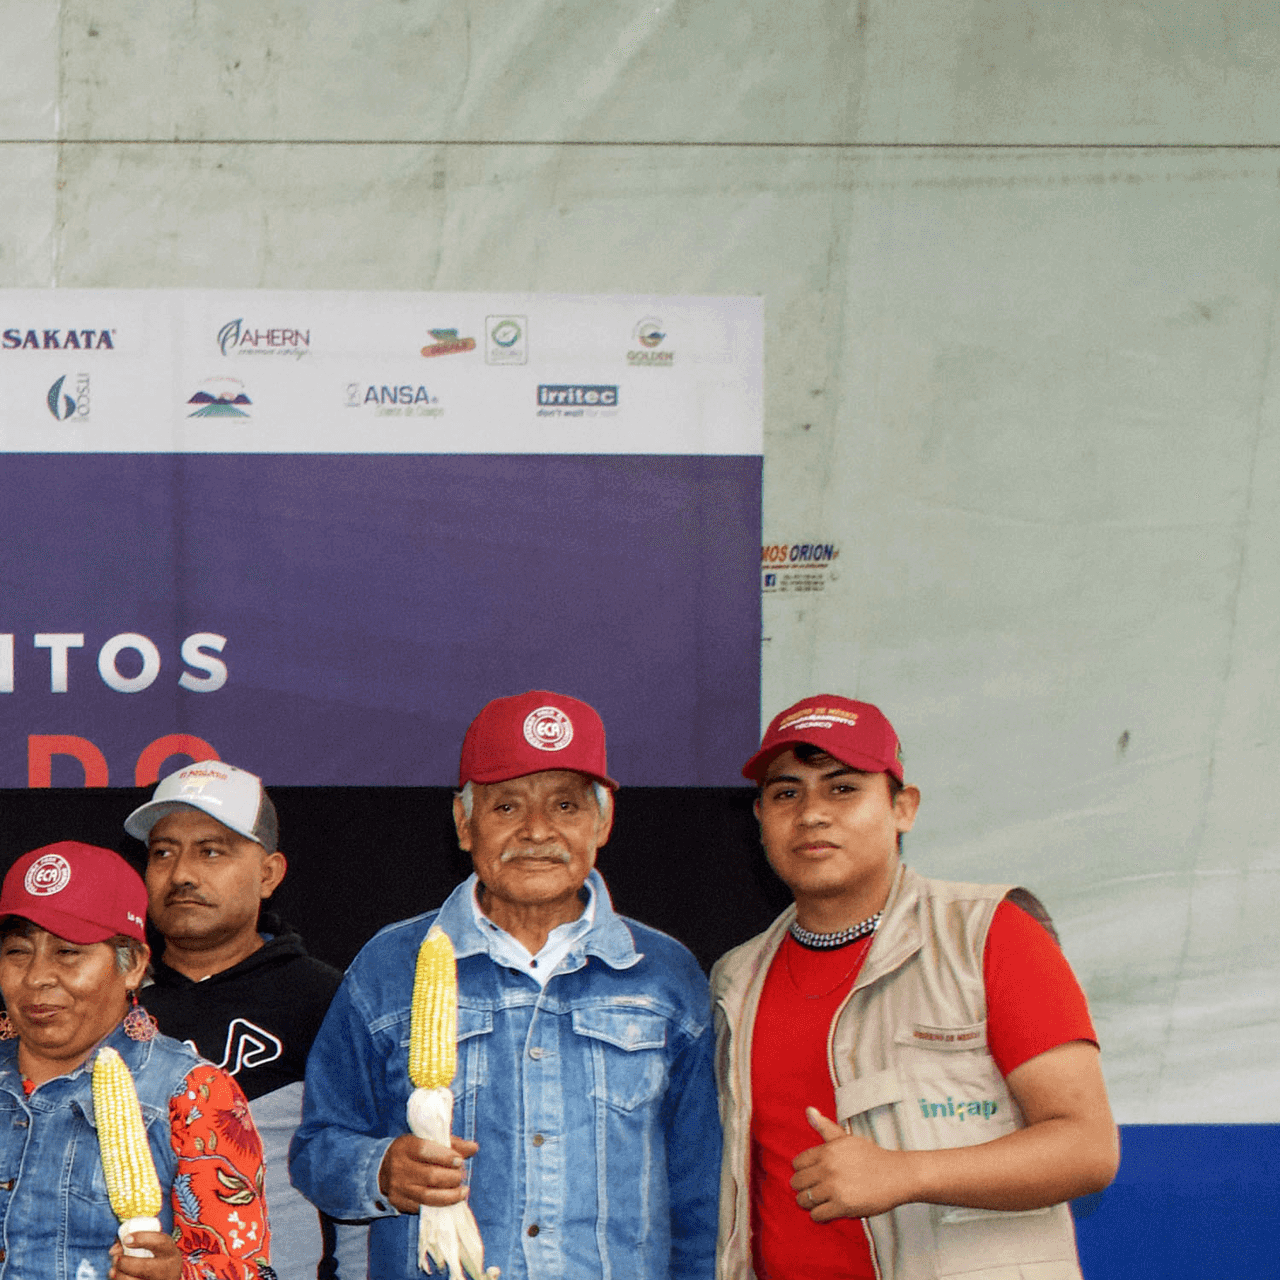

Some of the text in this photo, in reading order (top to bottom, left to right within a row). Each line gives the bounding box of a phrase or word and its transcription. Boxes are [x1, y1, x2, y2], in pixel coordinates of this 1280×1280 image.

[1, 328, 114, 350] SAKATA
[239, 329, 310, 347] AHERN
[363, 384, 430, 405] ANSA
[540, 386, 616, 406] irritec
[790, 544, 834, 562] ORION
